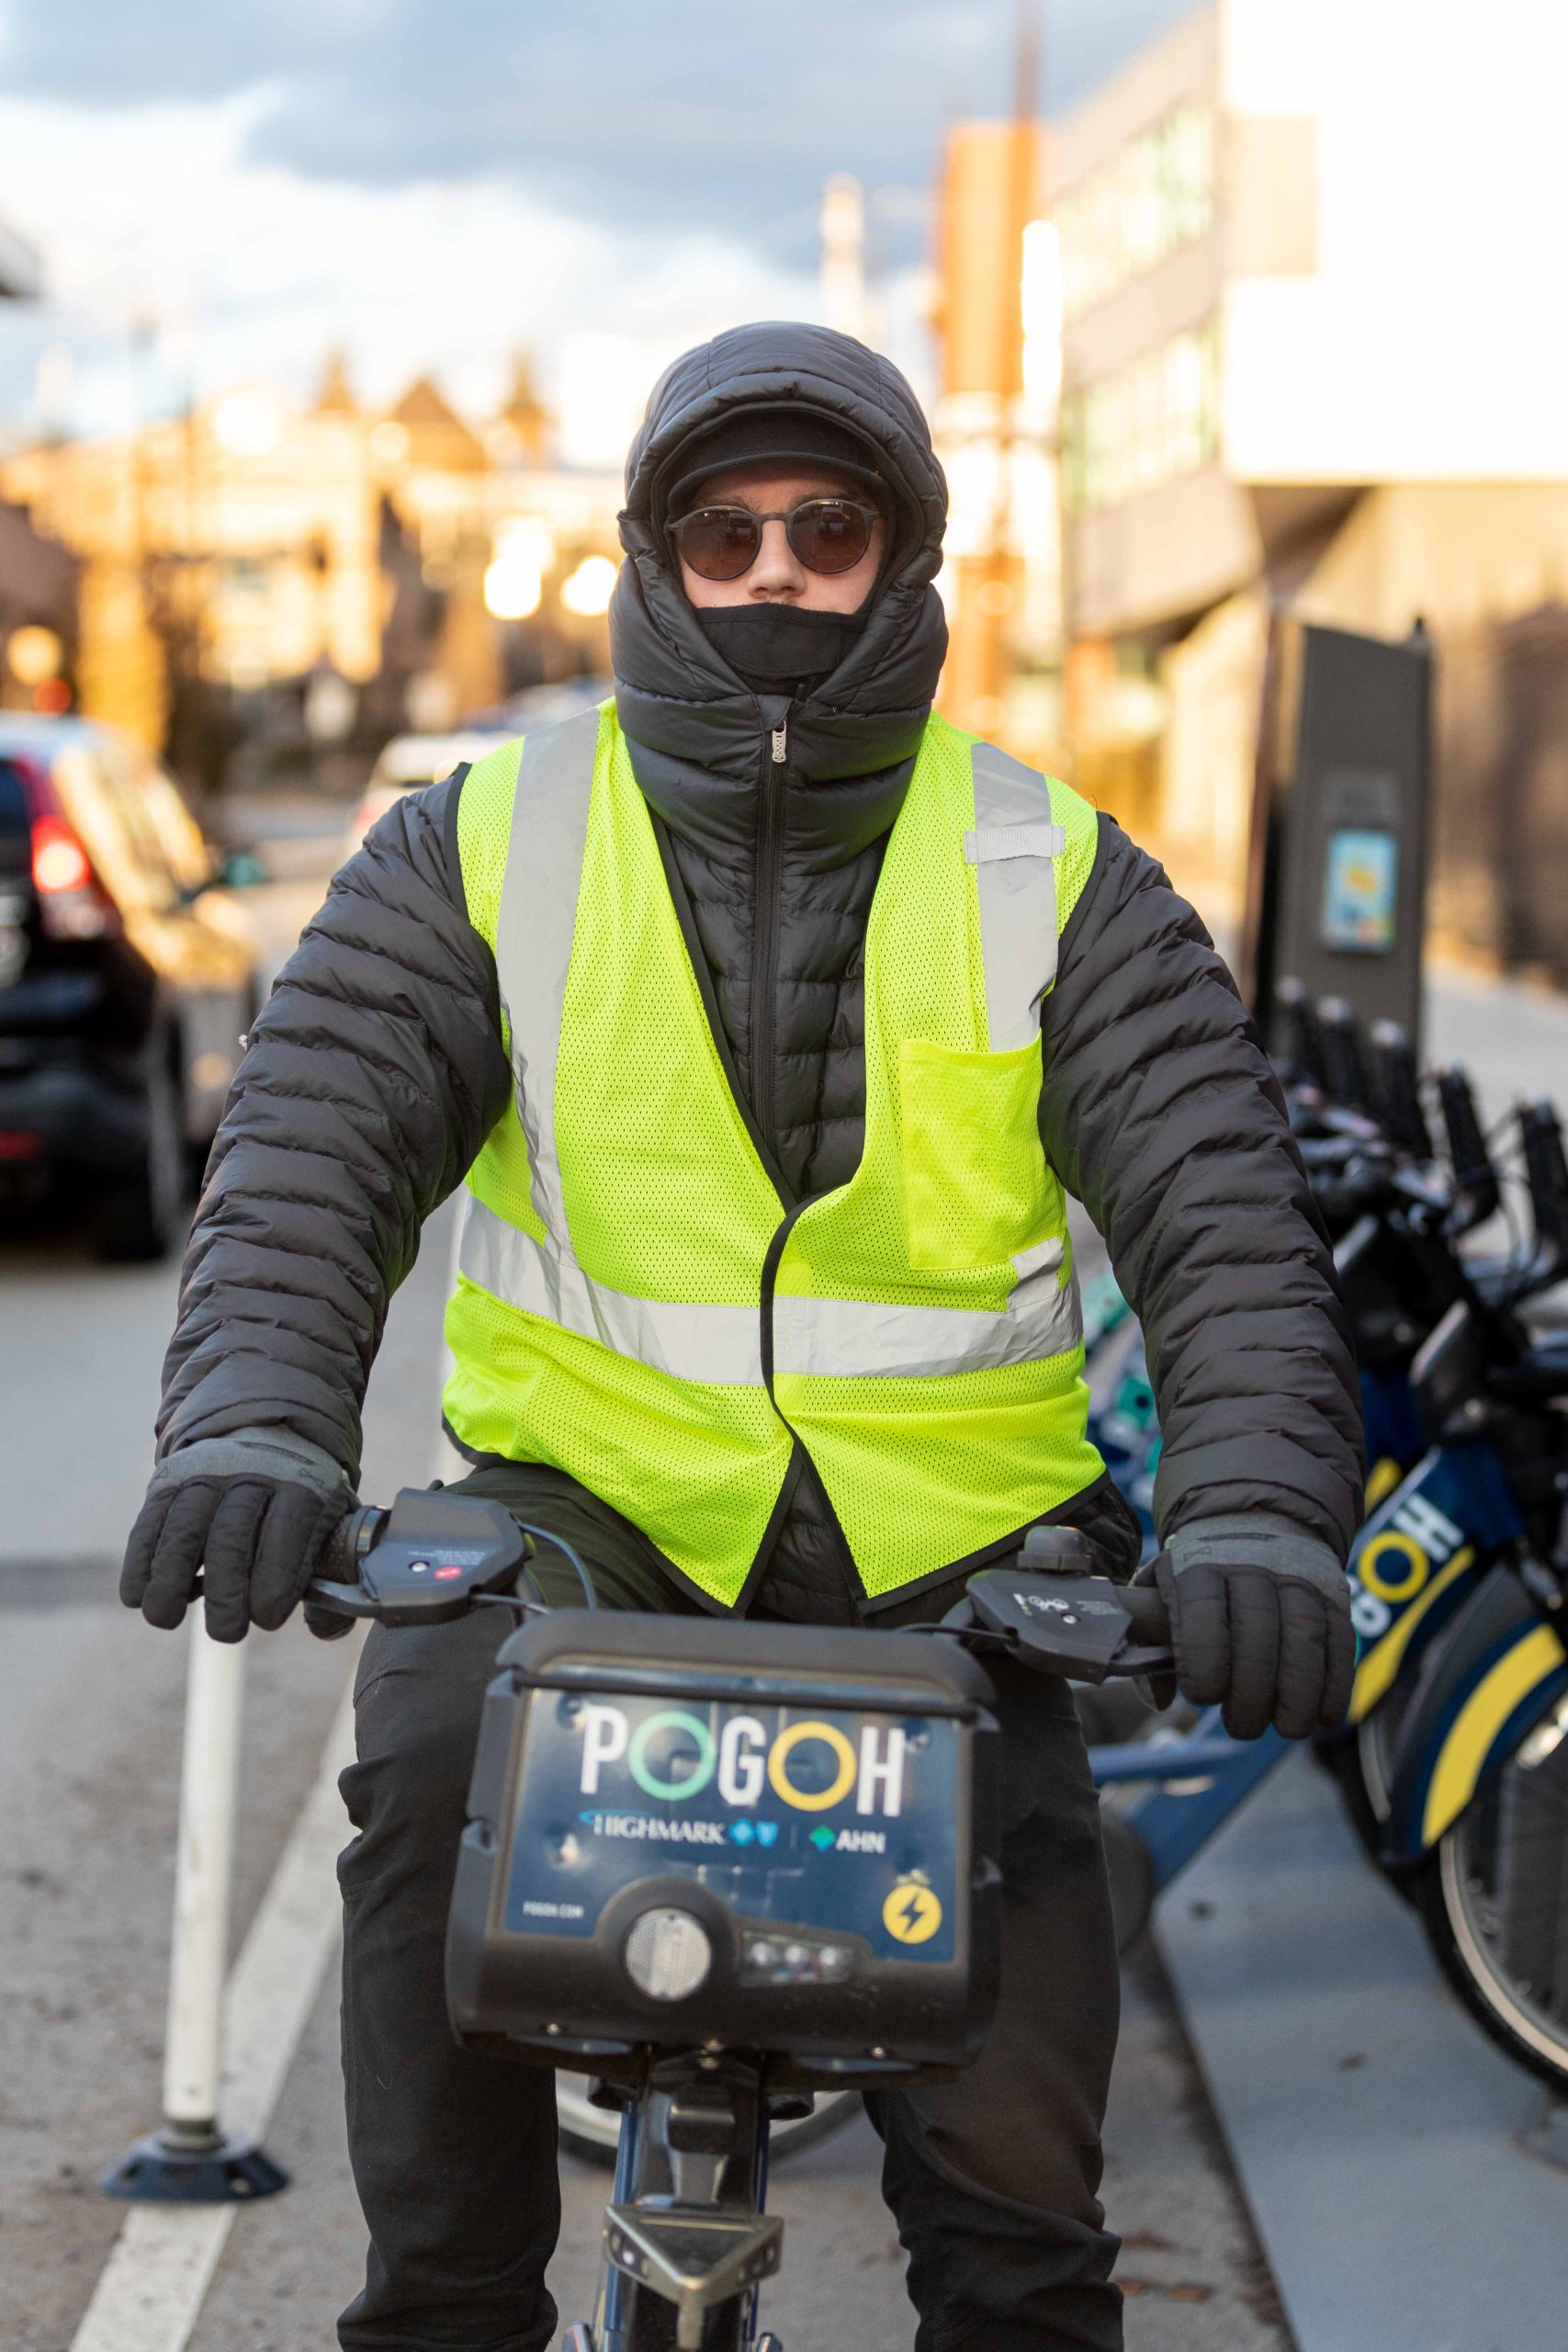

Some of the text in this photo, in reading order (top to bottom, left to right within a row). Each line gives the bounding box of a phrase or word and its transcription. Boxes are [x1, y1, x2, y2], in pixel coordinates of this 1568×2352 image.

[1346, 1493, 1465, 1654] GOH
[581, 1705, 905, 1816] POGOH
[592, 1814, 886, 1854] HIGHMARK AHN
